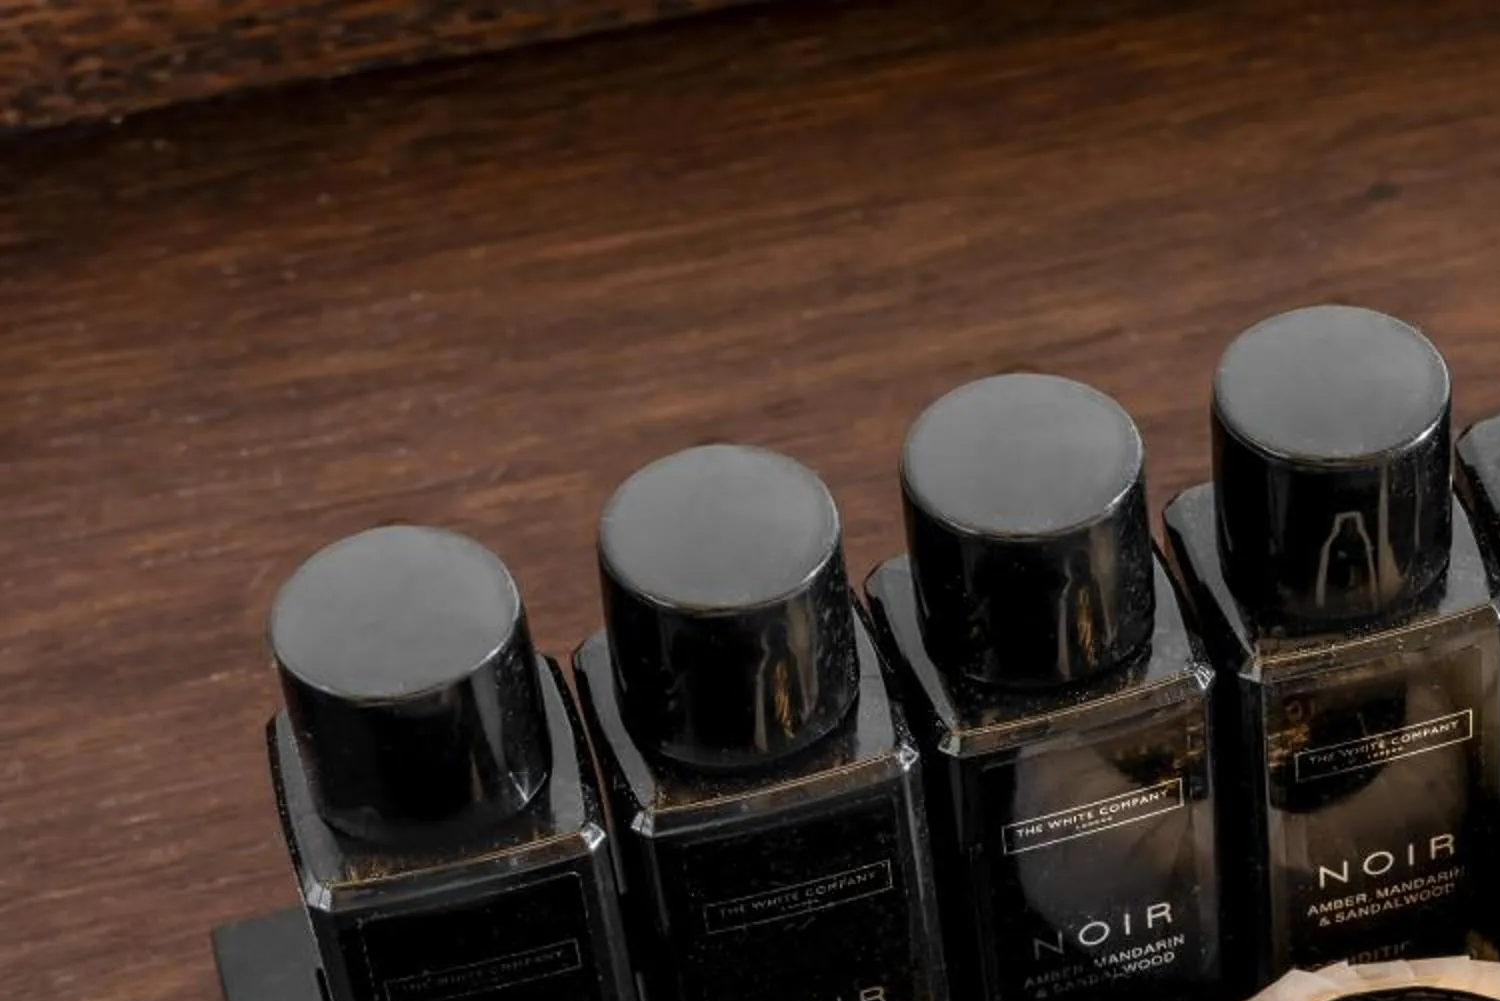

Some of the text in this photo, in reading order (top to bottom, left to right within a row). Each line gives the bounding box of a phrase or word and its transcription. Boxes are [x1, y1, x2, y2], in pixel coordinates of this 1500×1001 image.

[1391, 721, 1460, 745] COMPANY
[1016, 824, 1043, 839] THE
[1048, 810, 1094, 829] WHITE
[1099, 789, 1169, 816] COMPANY
[1319, 833, 1456, 889] NOIR
[804, 871, 877, 897] COMPANY
[1376, 864, 1466, 900] MANDARIN
[1335, 882, 1456, 924] SANDALWOOD
[1032, 901, 1173, 962] NOIR
[1093, 933, 1186, 968] MANDARIN
